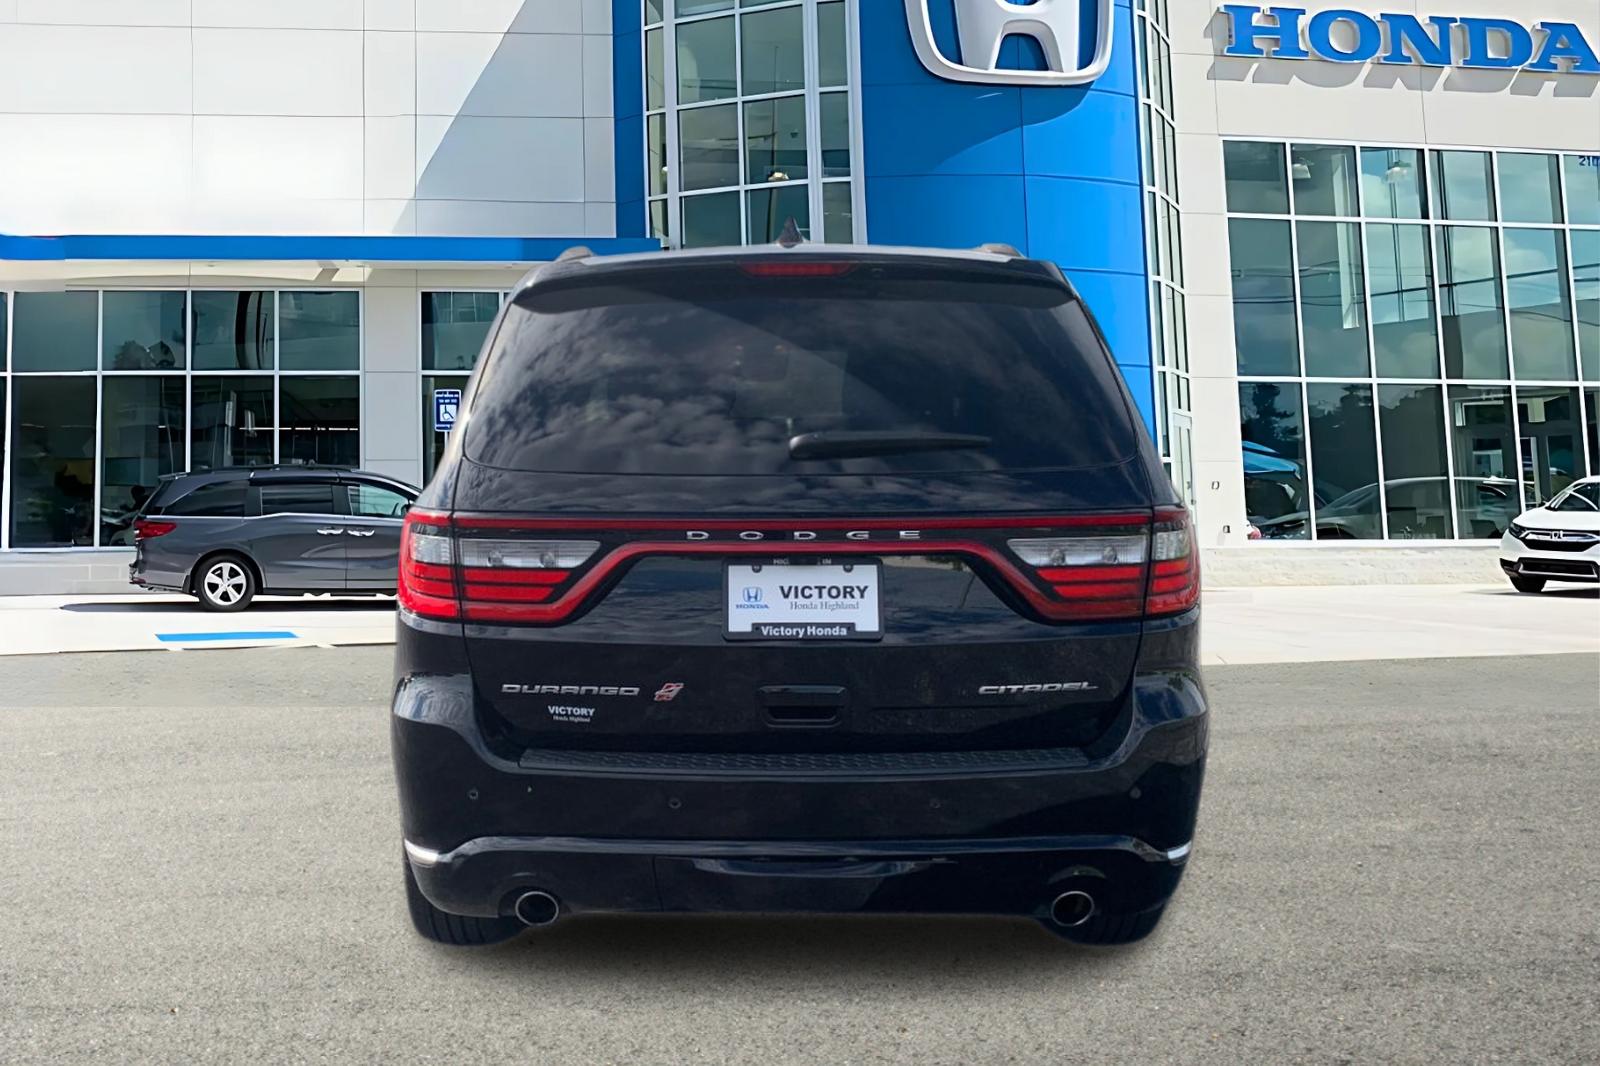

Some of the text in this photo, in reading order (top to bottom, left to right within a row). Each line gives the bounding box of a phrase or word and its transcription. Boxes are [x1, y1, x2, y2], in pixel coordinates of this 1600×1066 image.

[1222, 4, 1600, 73] HONDA
[686, 530, 921, 540] DODGE
[779, 585, 869, 599] VICTORY
[790, 601, 860, 612] Honda Highland
[760, 626, 848, 638] Victory Honda
[500, 684, 641, 697] DURANGO
[978, 681, 1099, 695] CITADEL
[547, 705, 596, 717] VICTORY
